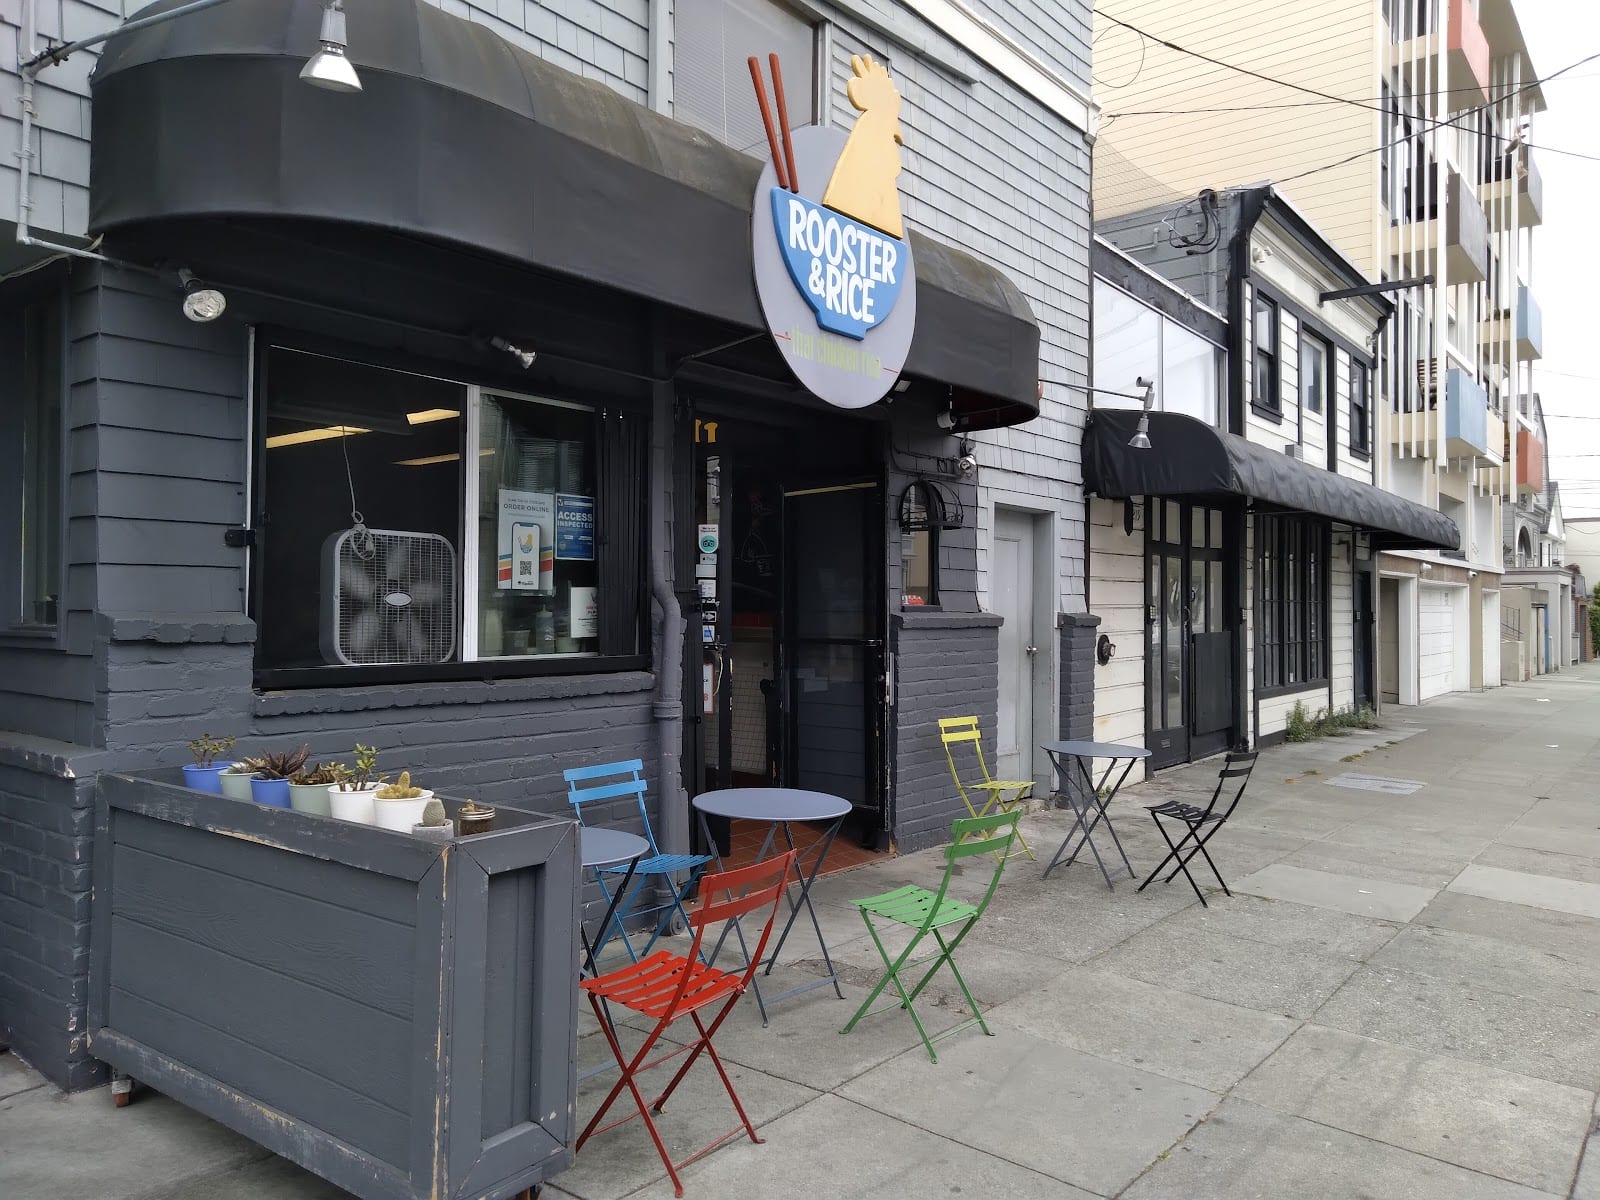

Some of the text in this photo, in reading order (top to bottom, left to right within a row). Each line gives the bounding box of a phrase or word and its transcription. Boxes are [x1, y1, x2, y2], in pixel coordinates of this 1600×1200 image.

[788, 199, 897, 284] ROOSTER
[526, 505, 550, 513] ONLINE
[558, 511, 593, 521] ACCESS
[558, 519, 593, 529] INSPECTED
